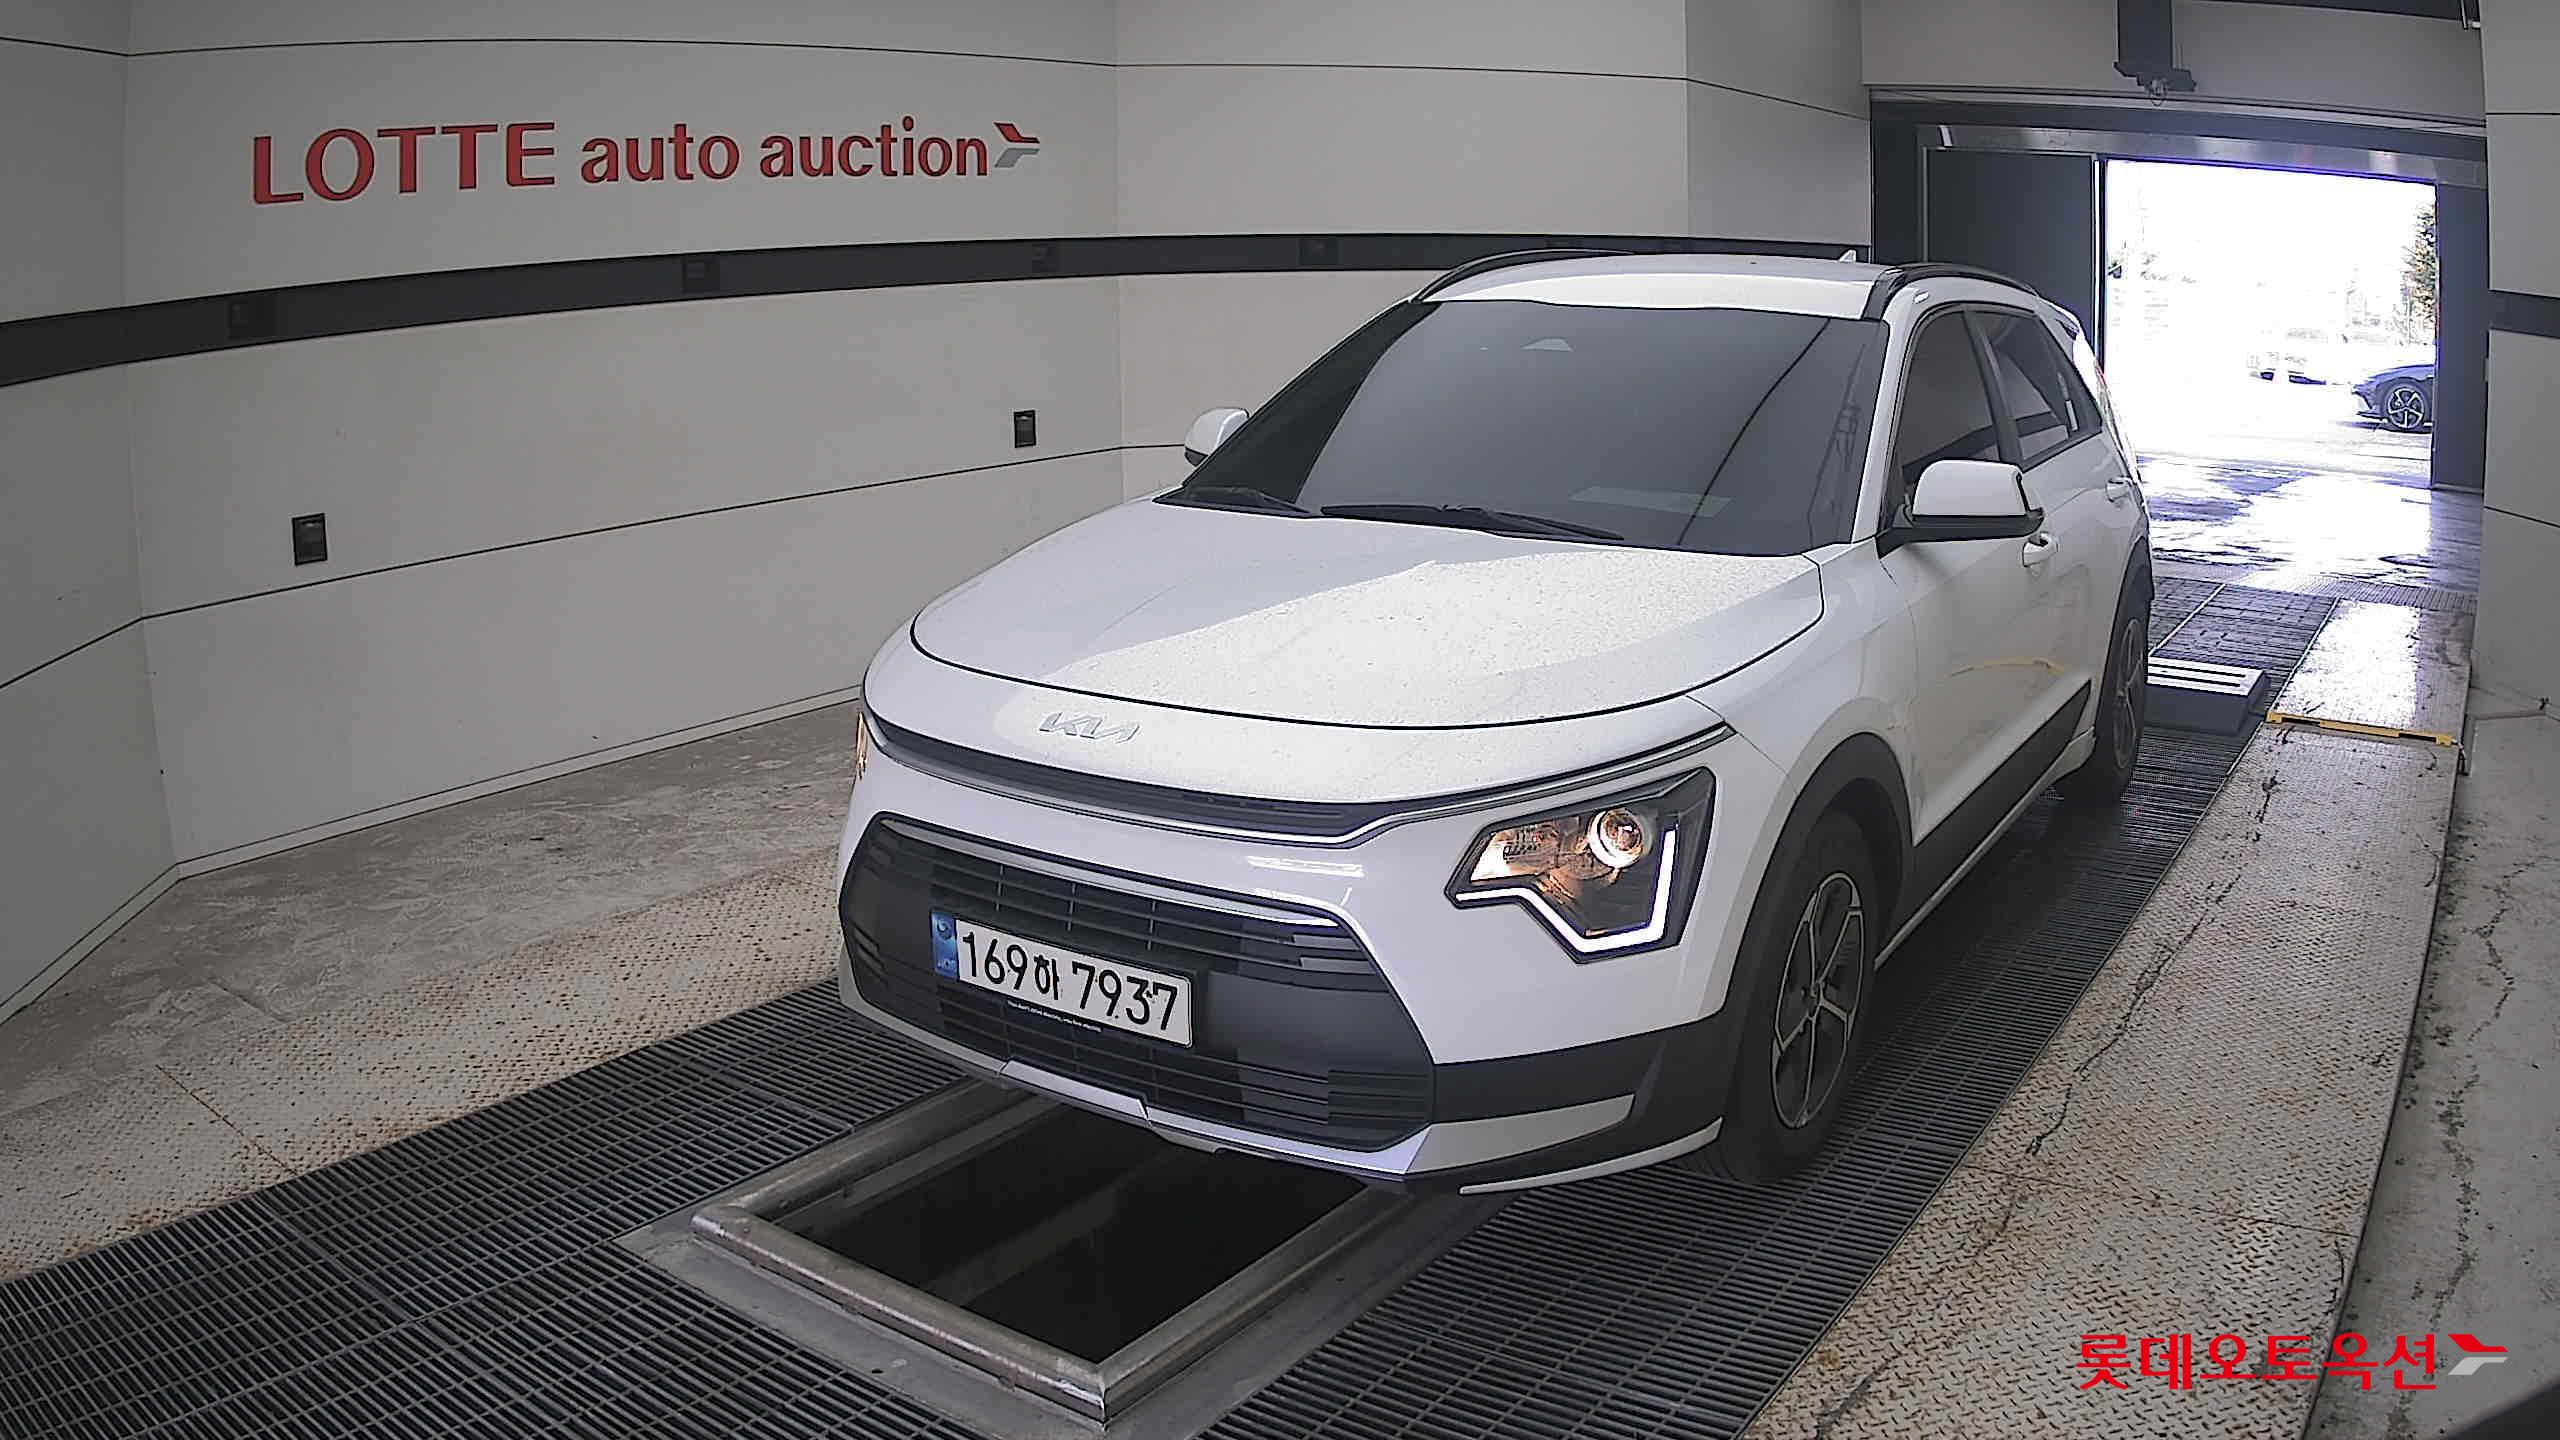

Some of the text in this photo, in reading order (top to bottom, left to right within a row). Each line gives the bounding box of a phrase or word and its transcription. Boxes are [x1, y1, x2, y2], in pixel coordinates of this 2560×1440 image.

[253, 115, 988, 204] LOTTE auto auction
[1039, 711, 1140, 744] KIA
[962, 931, 1060, 1001] 169하
[1072, 960, 1178, 1031] 7937
